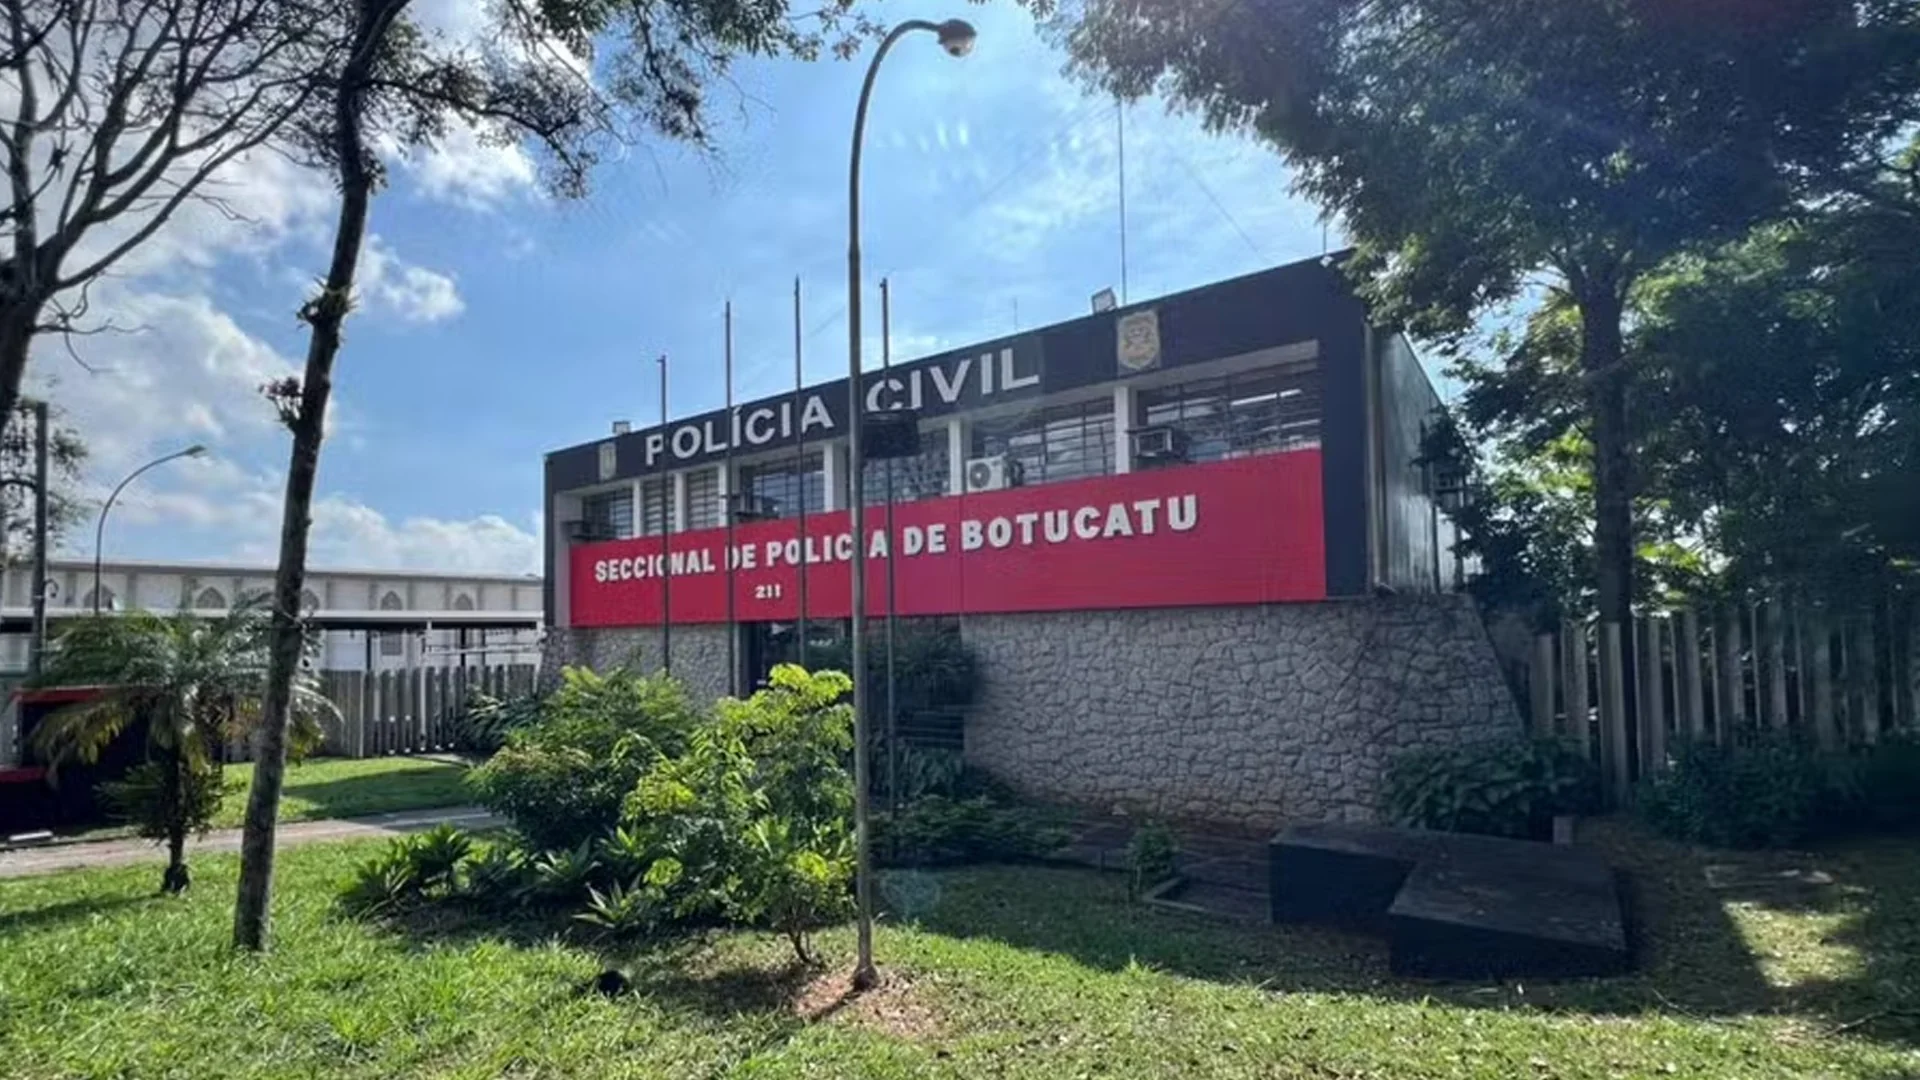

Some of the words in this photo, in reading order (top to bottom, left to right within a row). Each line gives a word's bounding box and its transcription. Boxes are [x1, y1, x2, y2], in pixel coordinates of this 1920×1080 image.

[645, 395, 834, 465] POLÍCIA
[866, 348, 1040, 412] CIVIL
[766, 529, 888, 567] POLICA
[903, 524, 946, 555] DE
[961, 494, 1197, 550] BOTUCATU
